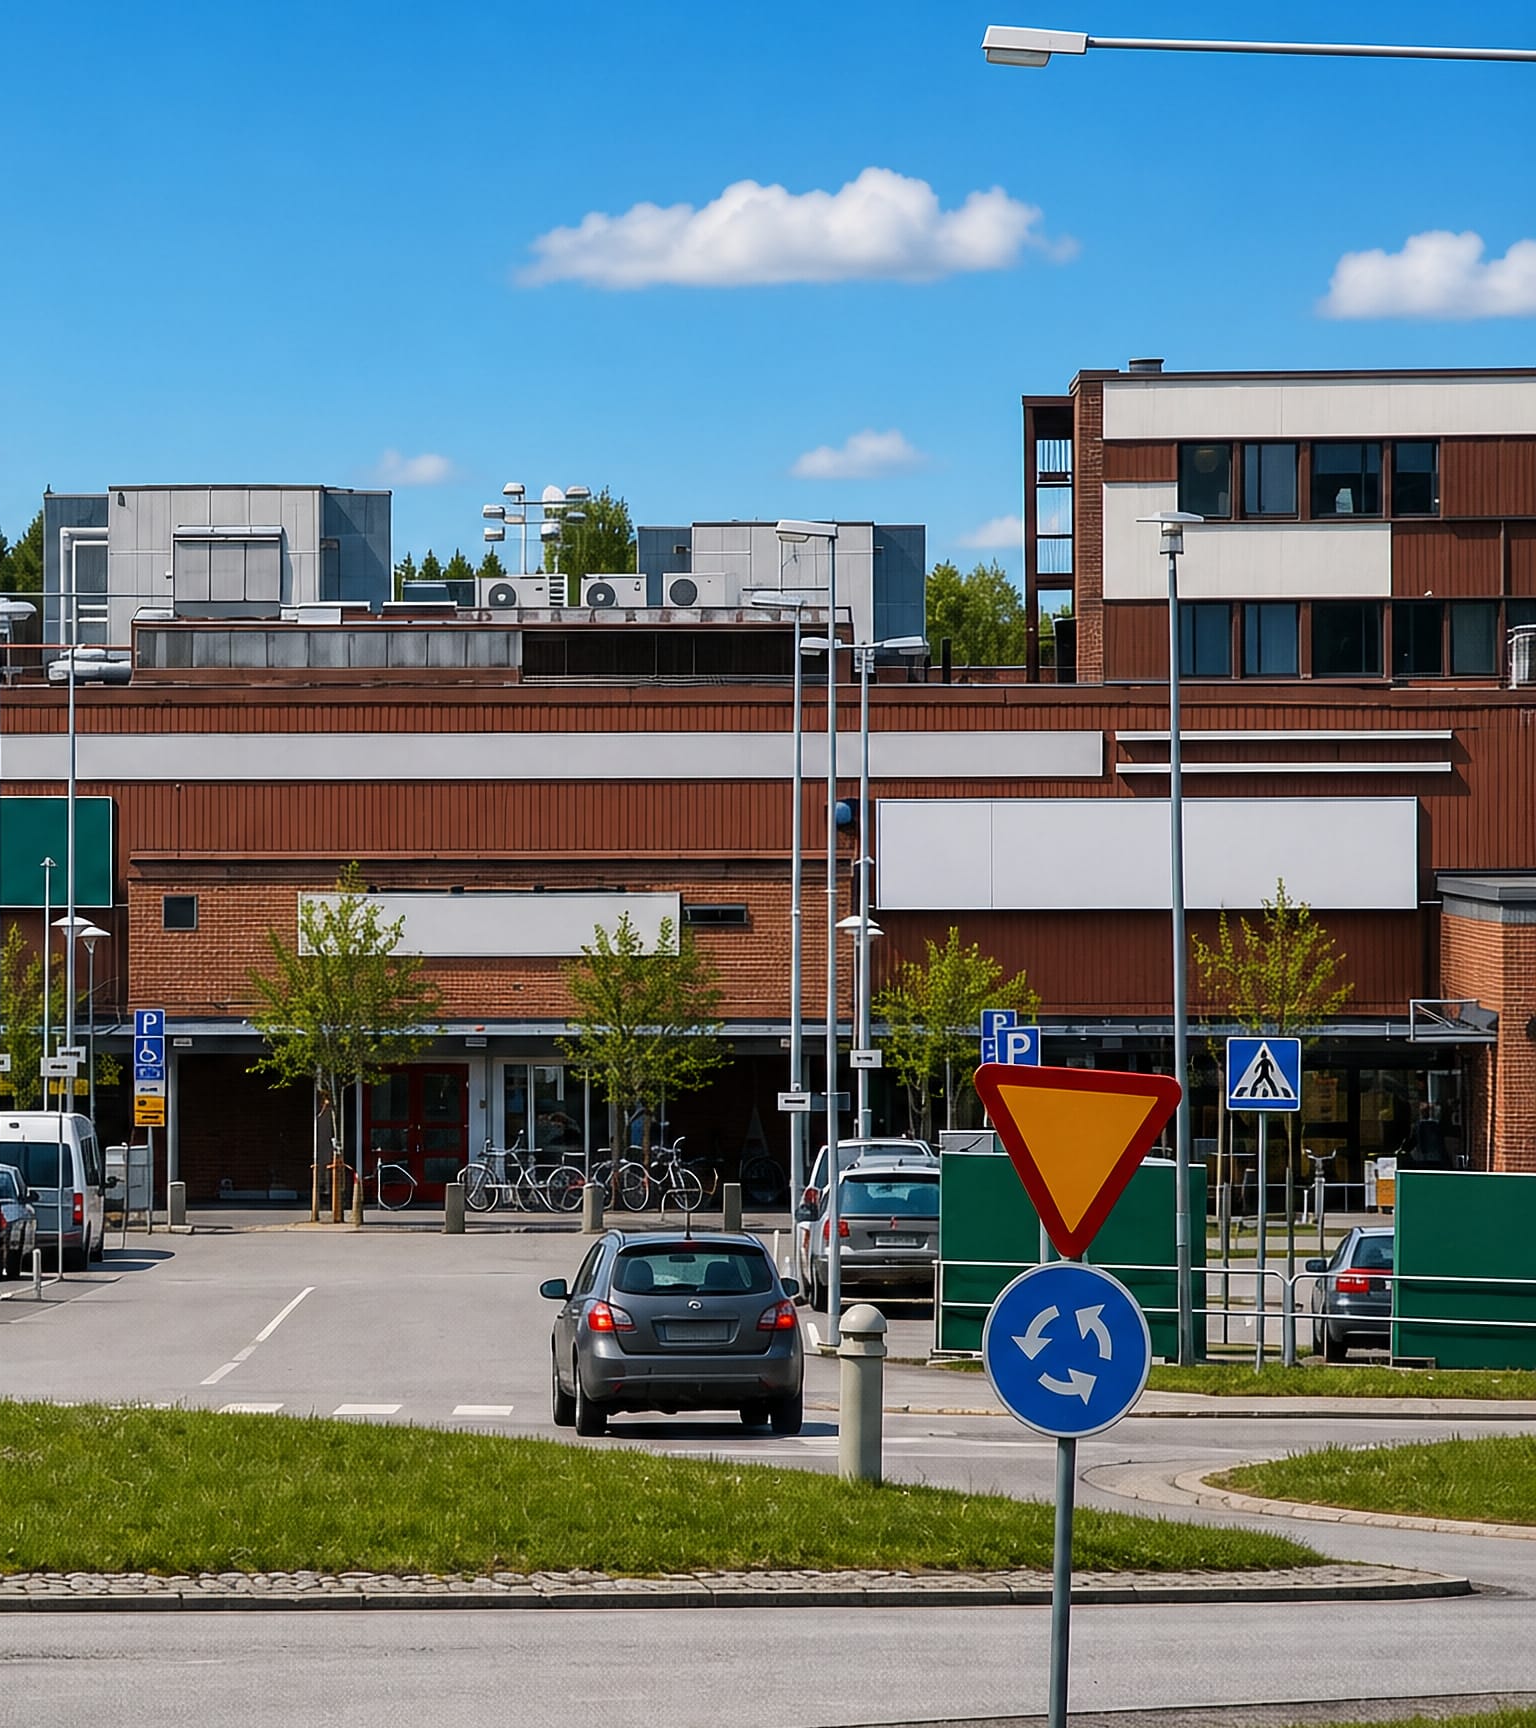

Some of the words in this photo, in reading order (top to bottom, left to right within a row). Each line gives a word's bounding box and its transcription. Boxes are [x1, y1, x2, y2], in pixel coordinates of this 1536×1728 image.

[144, 1013, 157, 1034] P
[993, 1014, 1007, 1030] P
[1007, 1033, 1031, 1065] P
